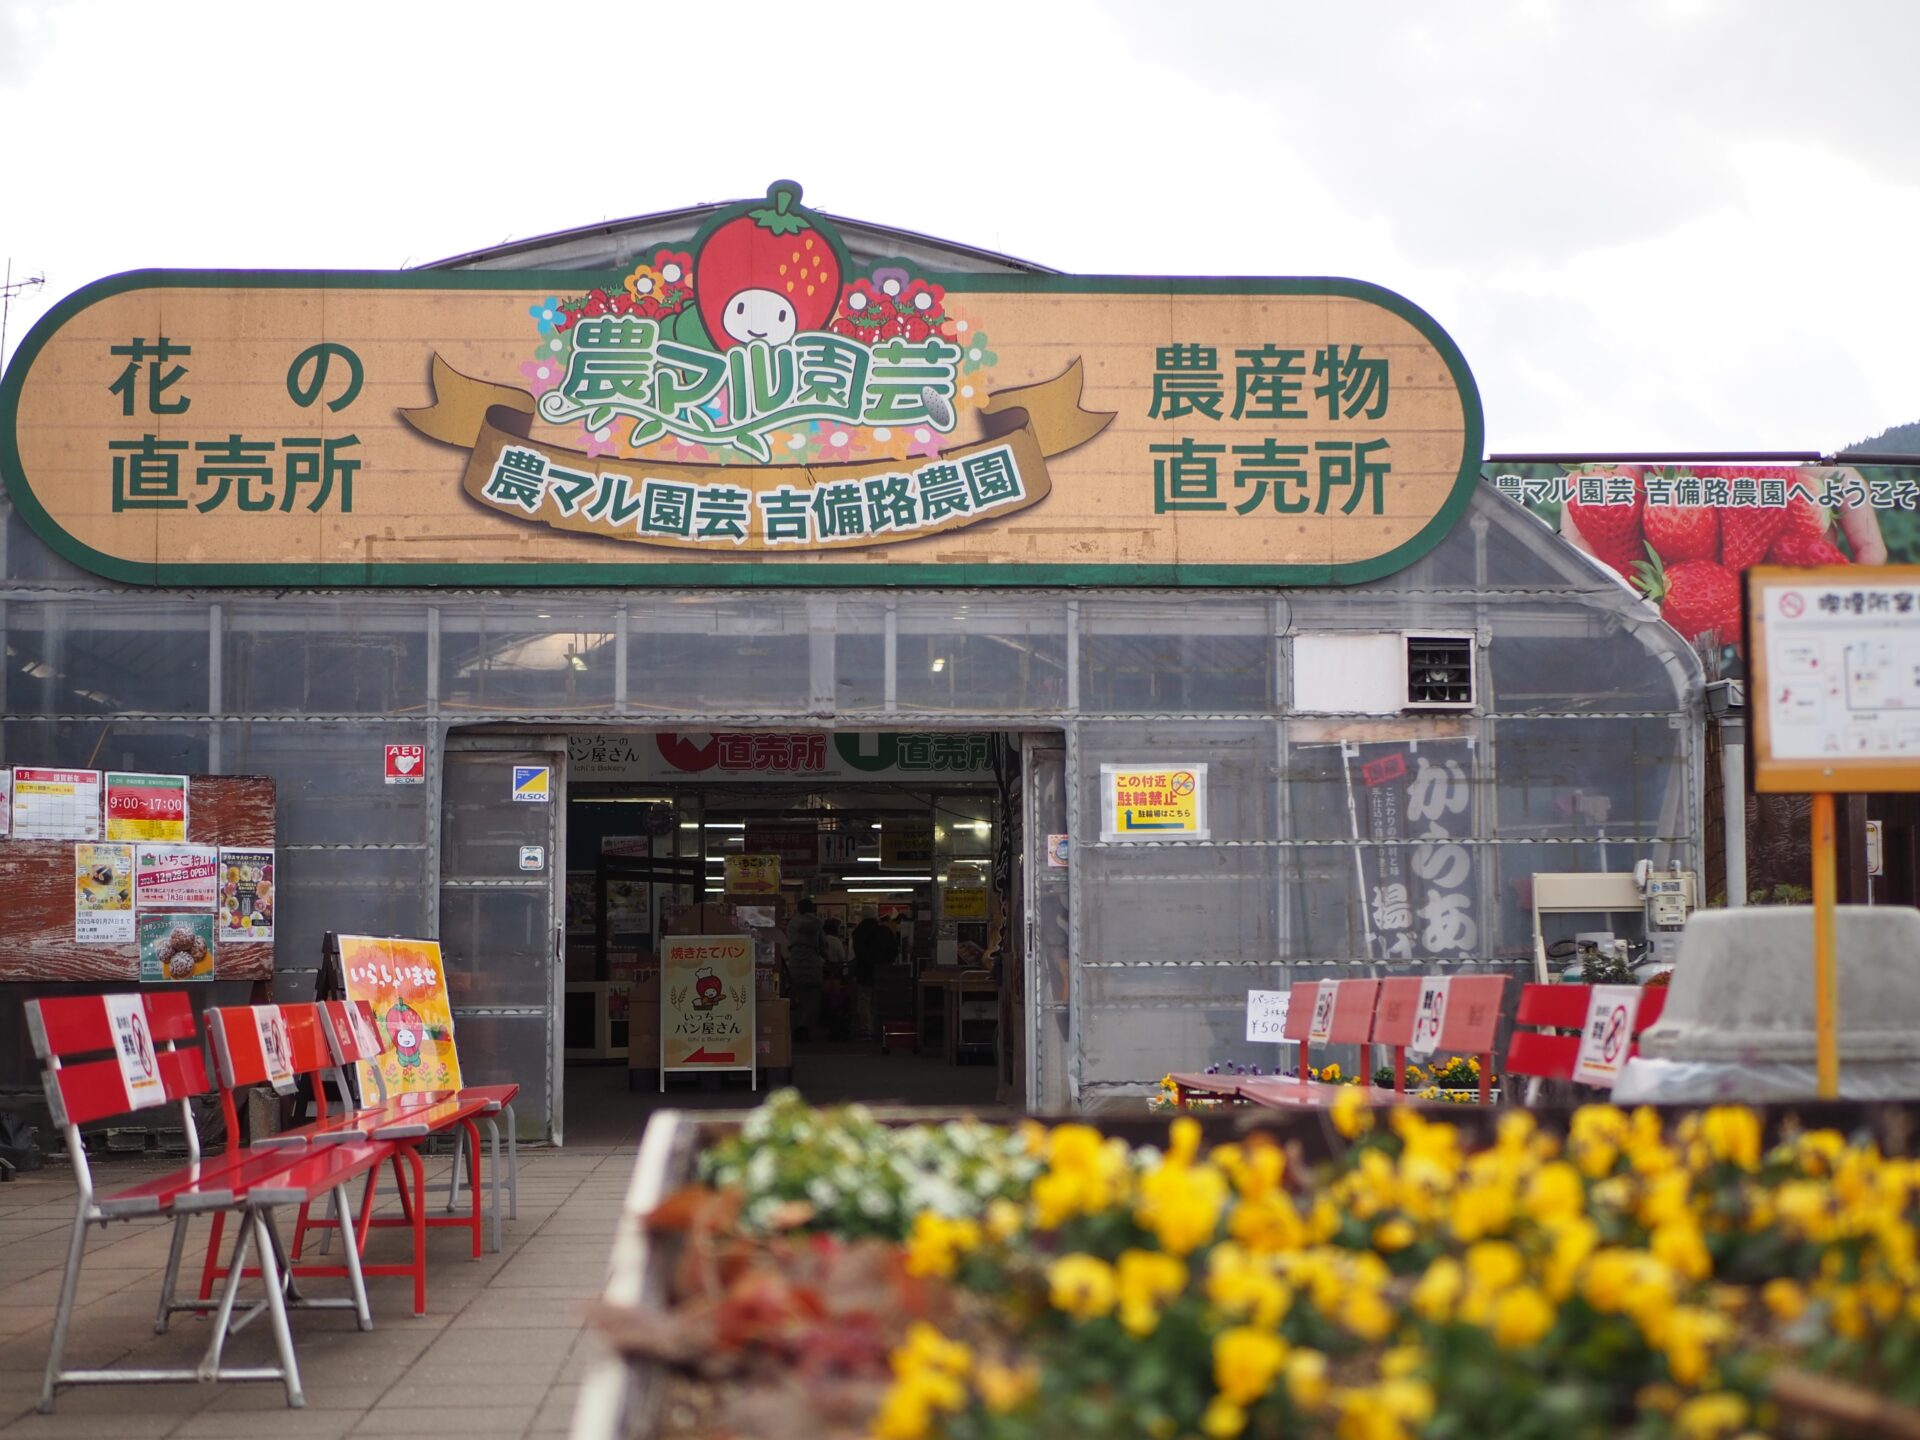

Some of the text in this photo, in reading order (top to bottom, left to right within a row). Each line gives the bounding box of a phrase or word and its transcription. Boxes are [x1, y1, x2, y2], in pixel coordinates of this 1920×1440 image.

[560, 316, 960, 430] 農マル園芸
[1147, 343, 1389, 421] 農産物
[109, 434, 362, 514] 直売所
[1149, 437, 1391, 515] 直売所
[486, 448, 1022, 542] 農マル園芸 吉備路農園
[1497, 475, 1920, 510] 農マル園芸 吉備路農園へようこそ
[389, 746, 422, 756] AED
[570, 734, 628, 747] いっちーの
[718, 733, 827, 770] 直売所
[1117, 775, 1167, 788] この付近
[1117, 791, 1178, 807] 駐輪禁止
[158, 854, 211, 866] いちご狩り
[671, 946, 745, 960] 焼きたてパン
[350, 962, 437, 989] いらっしゃいませ
[684, 1012, 733, 1021] いっちーの
[674, 1022, 742, 1035] パン屋さん
